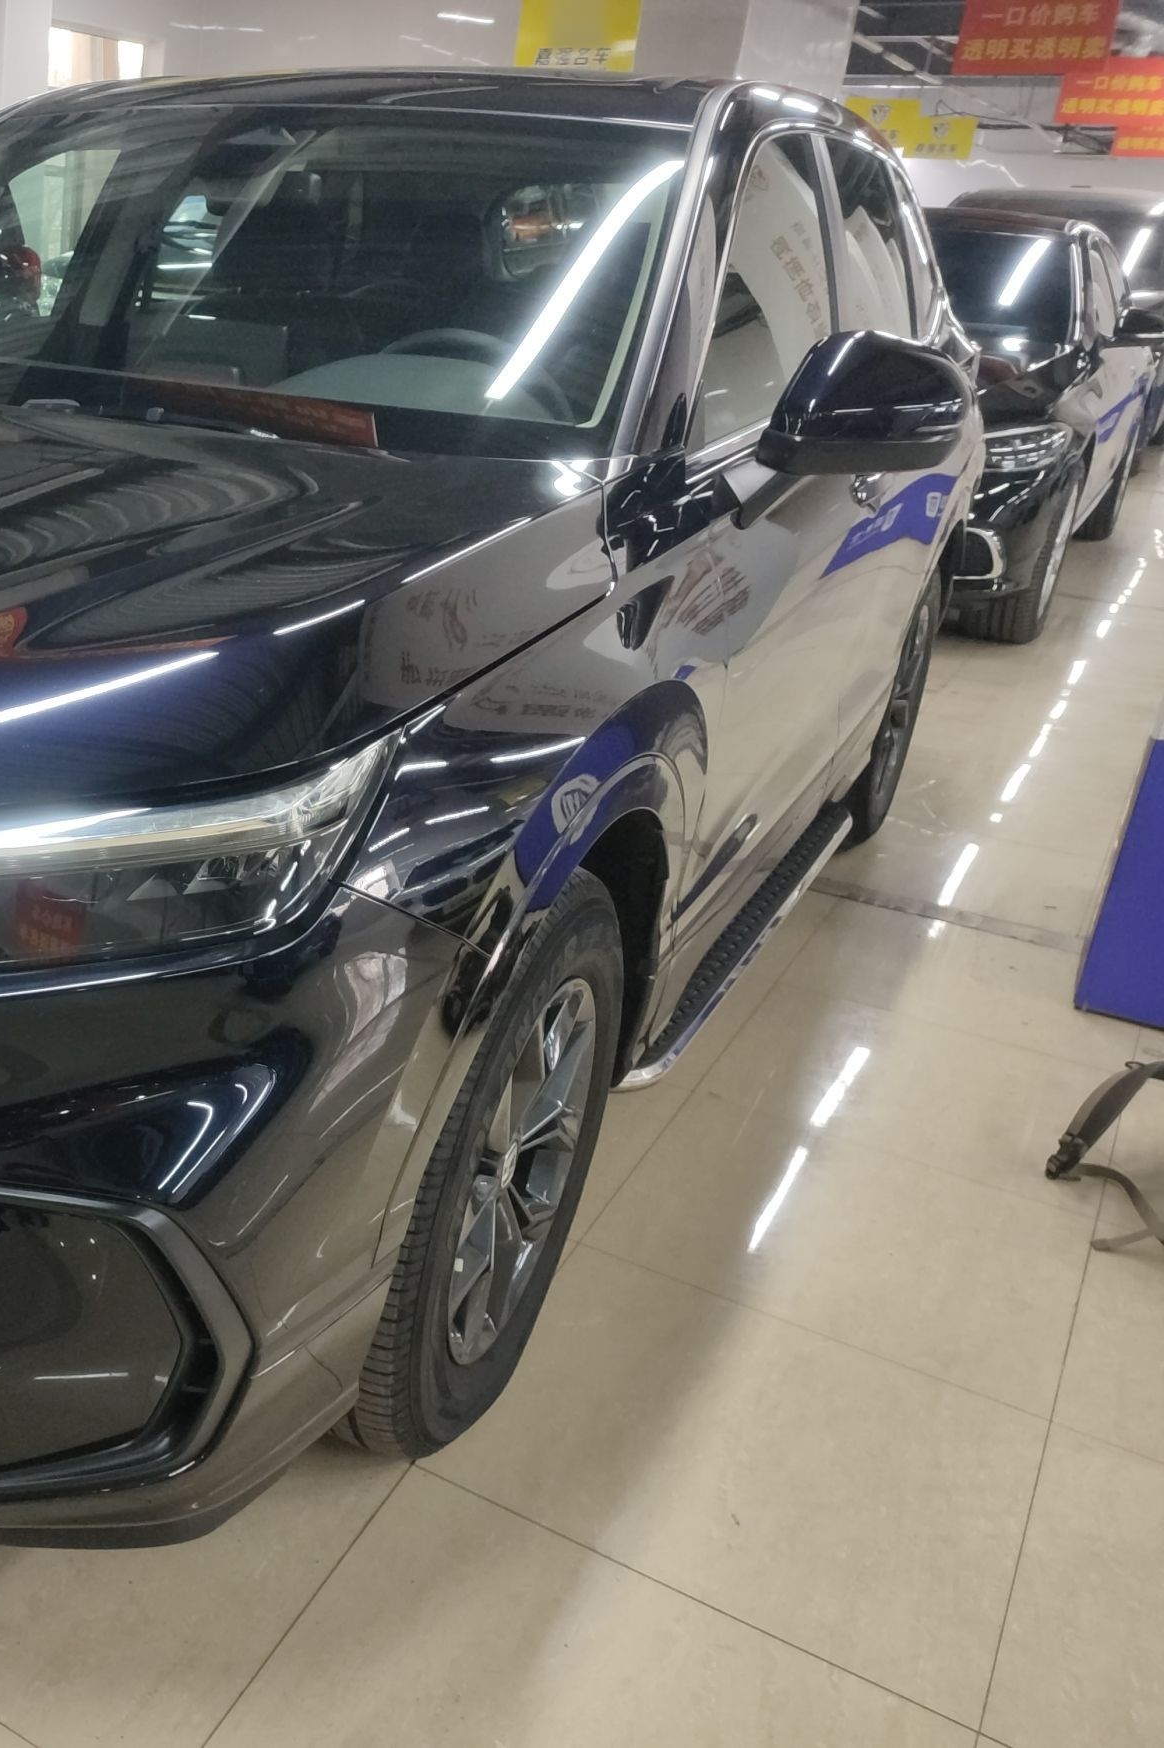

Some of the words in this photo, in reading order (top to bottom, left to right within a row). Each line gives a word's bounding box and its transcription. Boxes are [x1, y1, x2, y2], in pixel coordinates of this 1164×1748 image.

[981, 3, 1100, 26] 一口价购车
[961, 36, 1108, 61] 透明买透明卖
